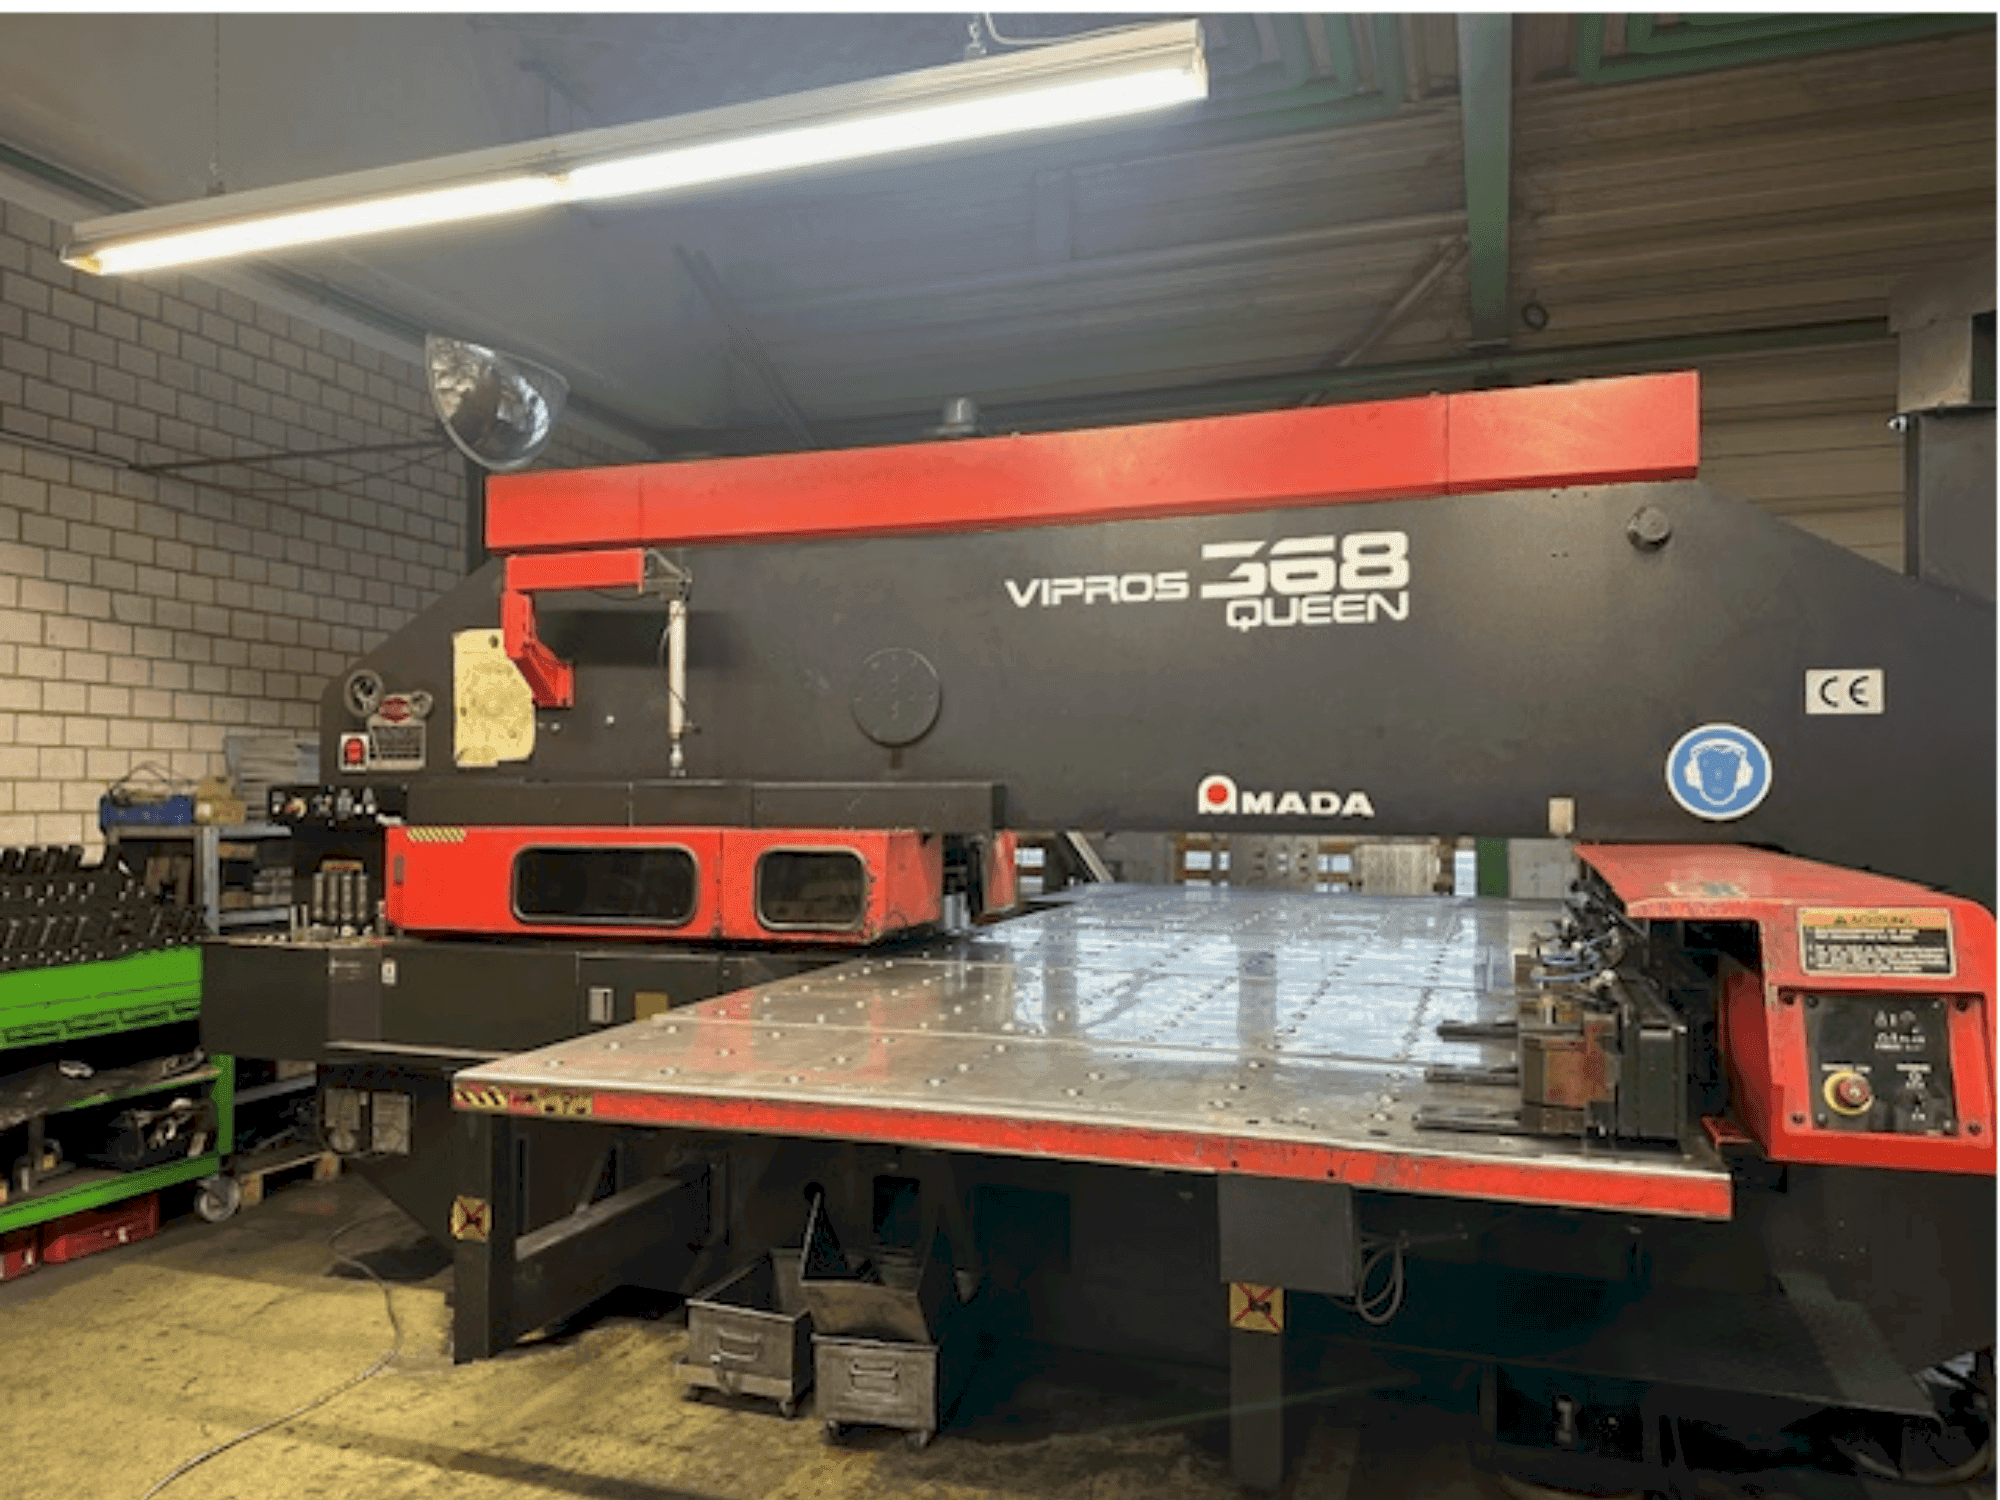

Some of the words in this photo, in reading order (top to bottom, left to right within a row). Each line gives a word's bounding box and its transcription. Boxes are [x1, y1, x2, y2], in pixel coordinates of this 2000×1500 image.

[1005, 571, 1189, 608] VIPROS
[1201, 531, 1410, 599] 368
[1226, 592, 1410, 632] QUEEN
[1819, 675, 1869, 708] CE
[1198, 775, 1375, 817] AMADA
